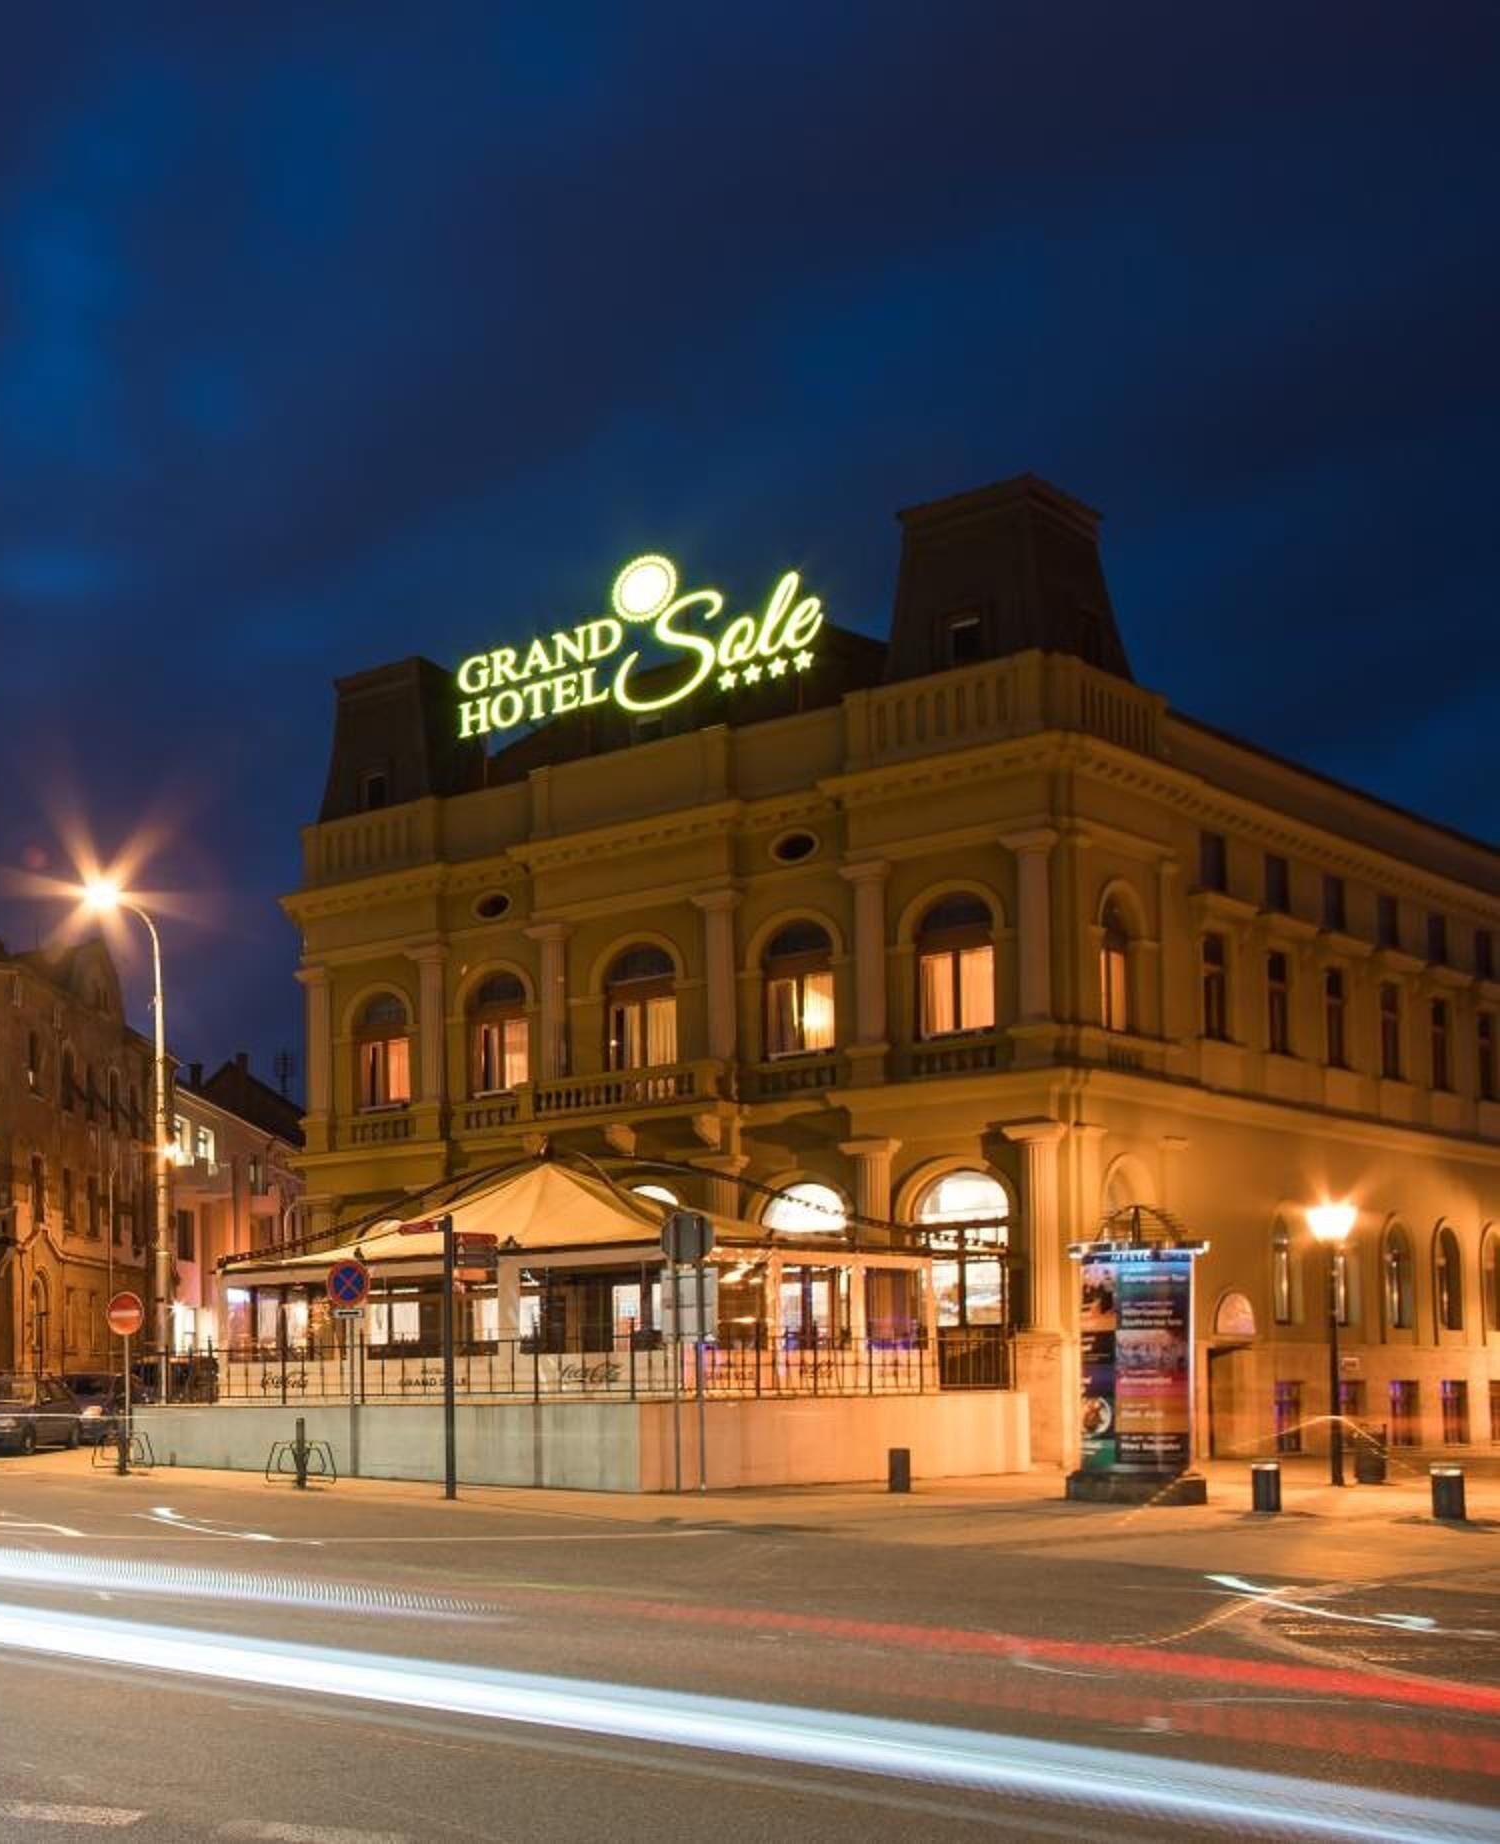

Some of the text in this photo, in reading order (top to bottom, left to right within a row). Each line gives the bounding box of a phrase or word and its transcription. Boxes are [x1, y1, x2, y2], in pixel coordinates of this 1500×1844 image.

[457, 618, 623, 695] GRAND
[615, 571, 823, 711] Sole
[457, 667, 610, 739] HOTEL
